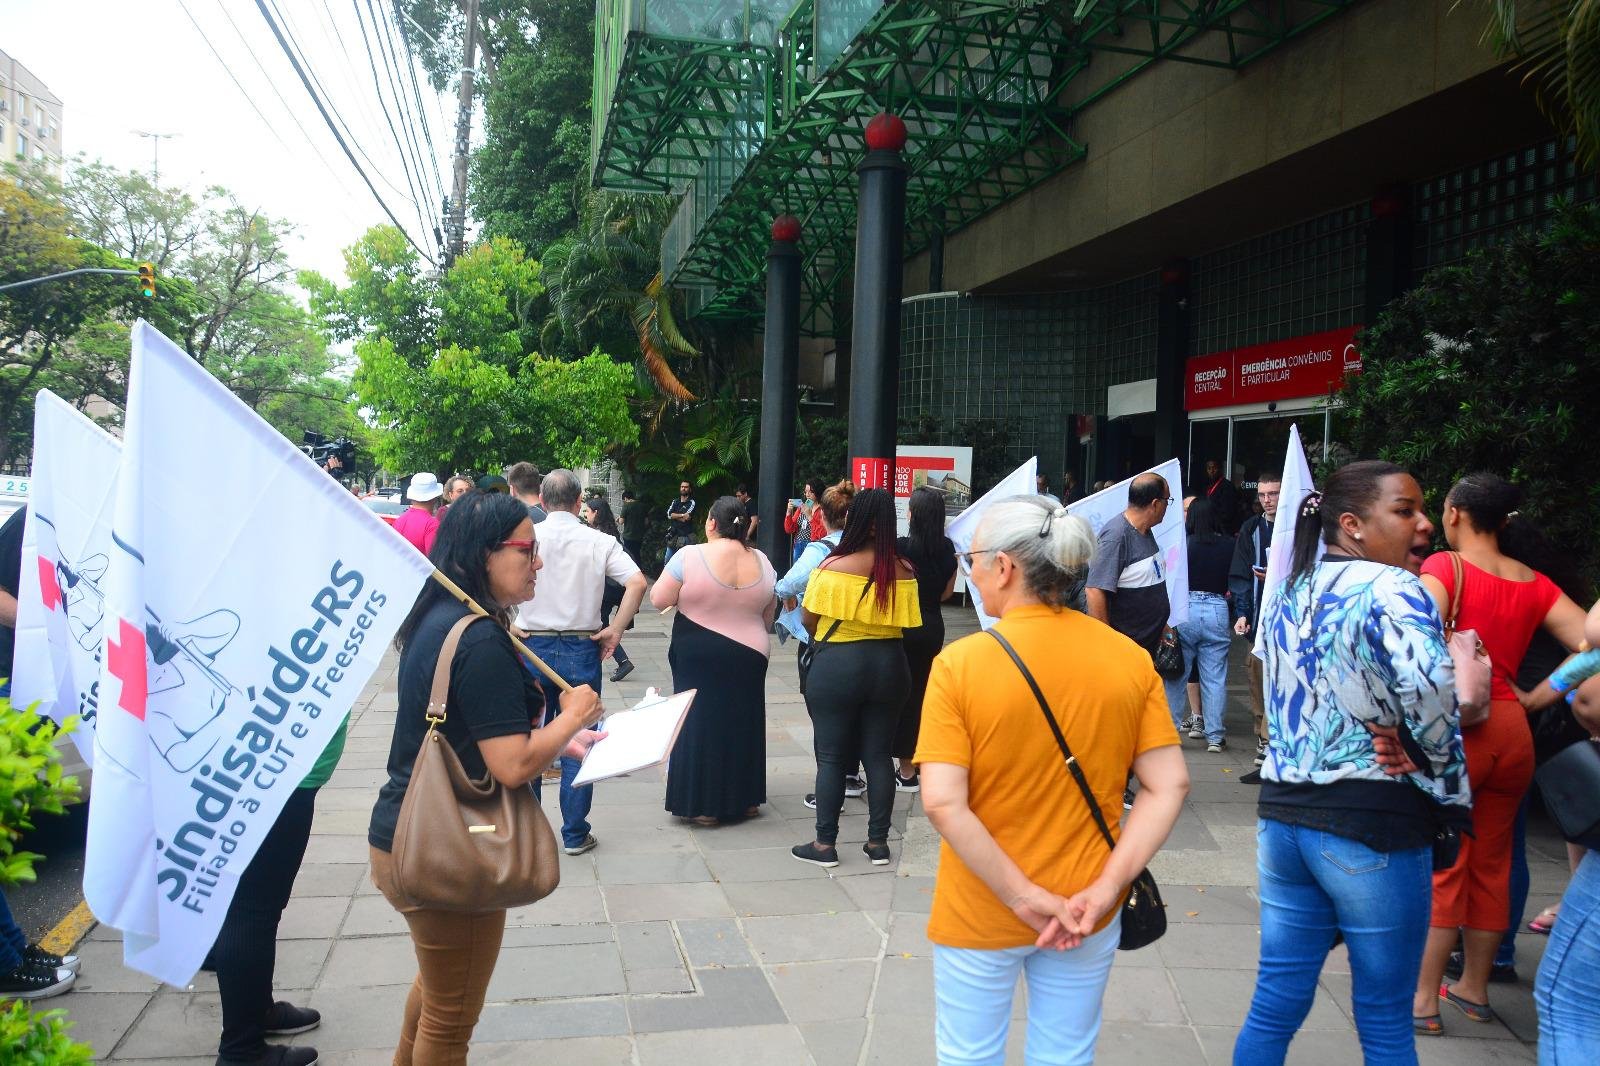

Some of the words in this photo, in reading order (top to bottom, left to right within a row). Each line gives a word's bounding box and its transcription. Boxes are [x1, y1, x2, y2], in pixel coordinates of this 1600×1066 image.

[1241, 357, 1287, 375] EMERGÊNCIA
[1288, 350, 1332, 367] CONVÊNIOS
[1194, 366, 1227, 383] RECEPÇÃO
[1241, 376, 1246, 387] E
[1247, 369, 1290, 386] PARTICULAR
[1194, 381, 1223, 394] CENTRAL
[311, 588, 388, 699] Feessers
[297, 700, 323, 720] à
[156, 559, 365, 903] Sindisaúde-RS
[290, 721, 311, 740] e
[253, 734, 296, 791] CUT
[237, 797, 261, 814] à
[182, 819, 248, 914] Filiado
